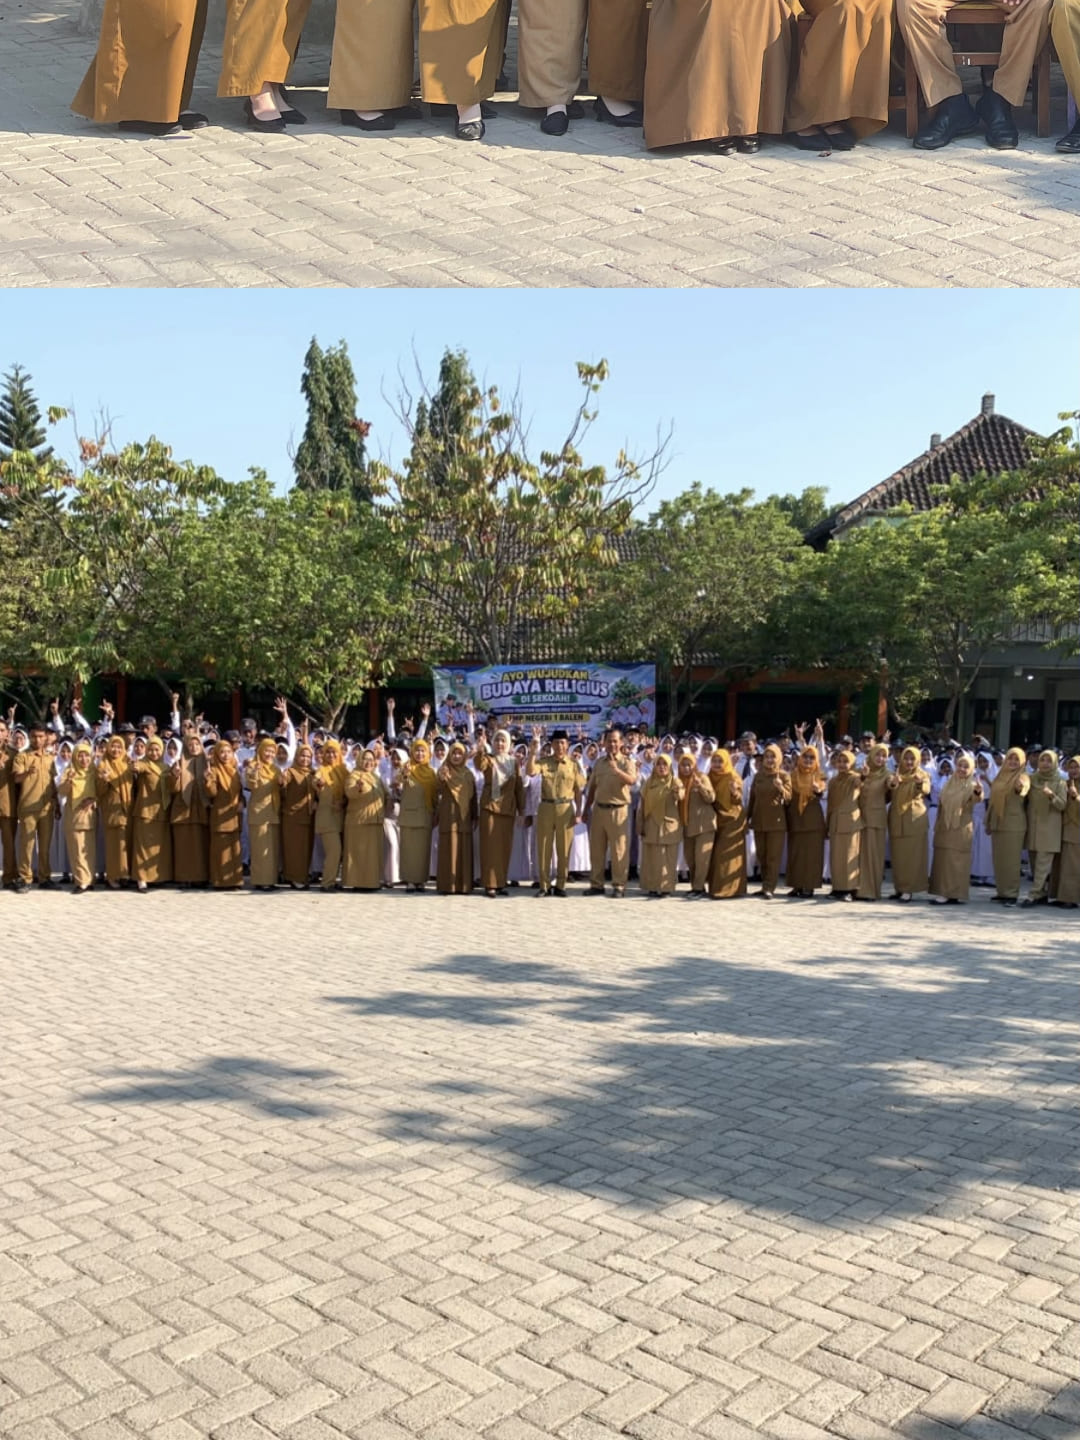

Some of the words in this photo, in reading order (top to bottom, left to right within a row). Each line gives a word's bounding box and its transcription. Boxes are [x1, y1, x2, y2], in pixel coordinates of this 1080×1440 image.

[503, 671, 523, 681] AYO
[527, 669, 588, 679] WUJUDKAN
[482, 680, 540, 699] BUDAYA
[545, 679, 609, 697] RELIGIUS
[521, 695, 529, 703] DI
